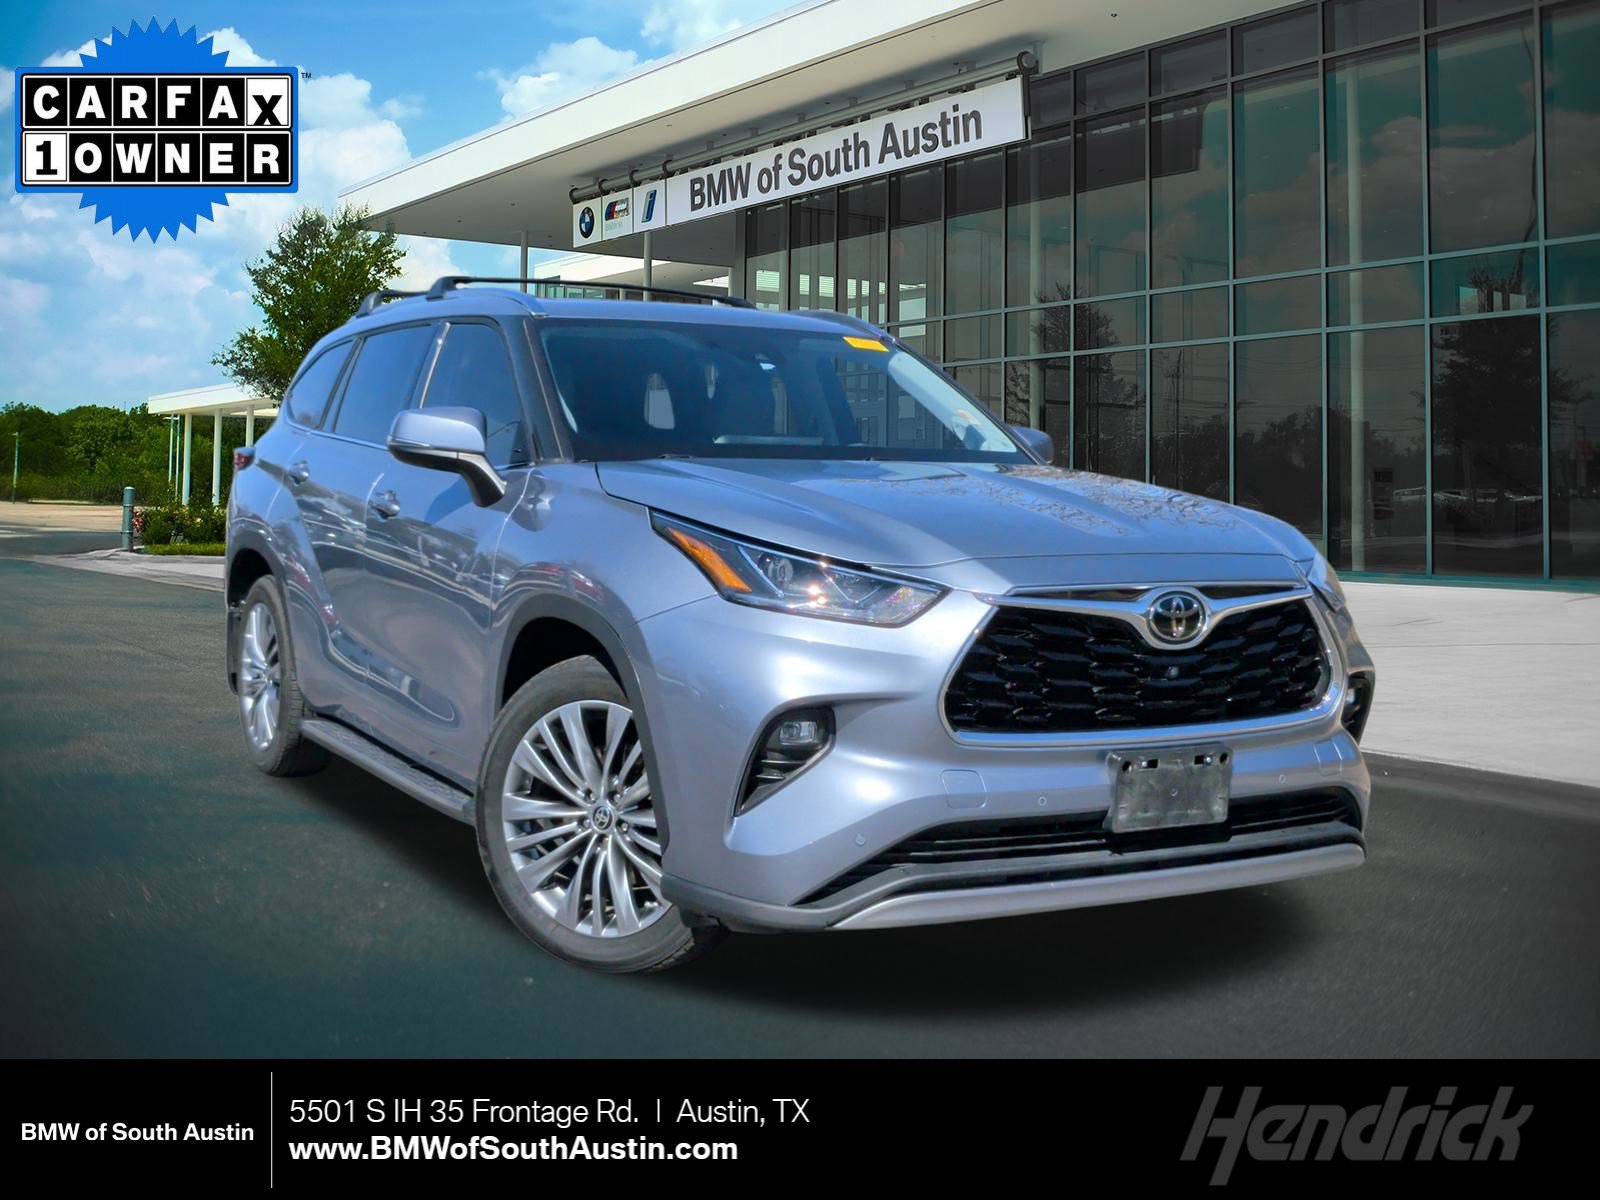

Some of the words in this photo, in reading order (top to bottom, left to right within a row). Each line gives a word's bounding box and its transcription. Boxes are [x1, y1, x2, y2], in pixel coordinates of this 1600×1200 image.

[689, 162, 752, 212] BMW
[757, 153, 783, 194] of
[787, 131, 871, 187] South
[877, 104, 983, 165] Austin
